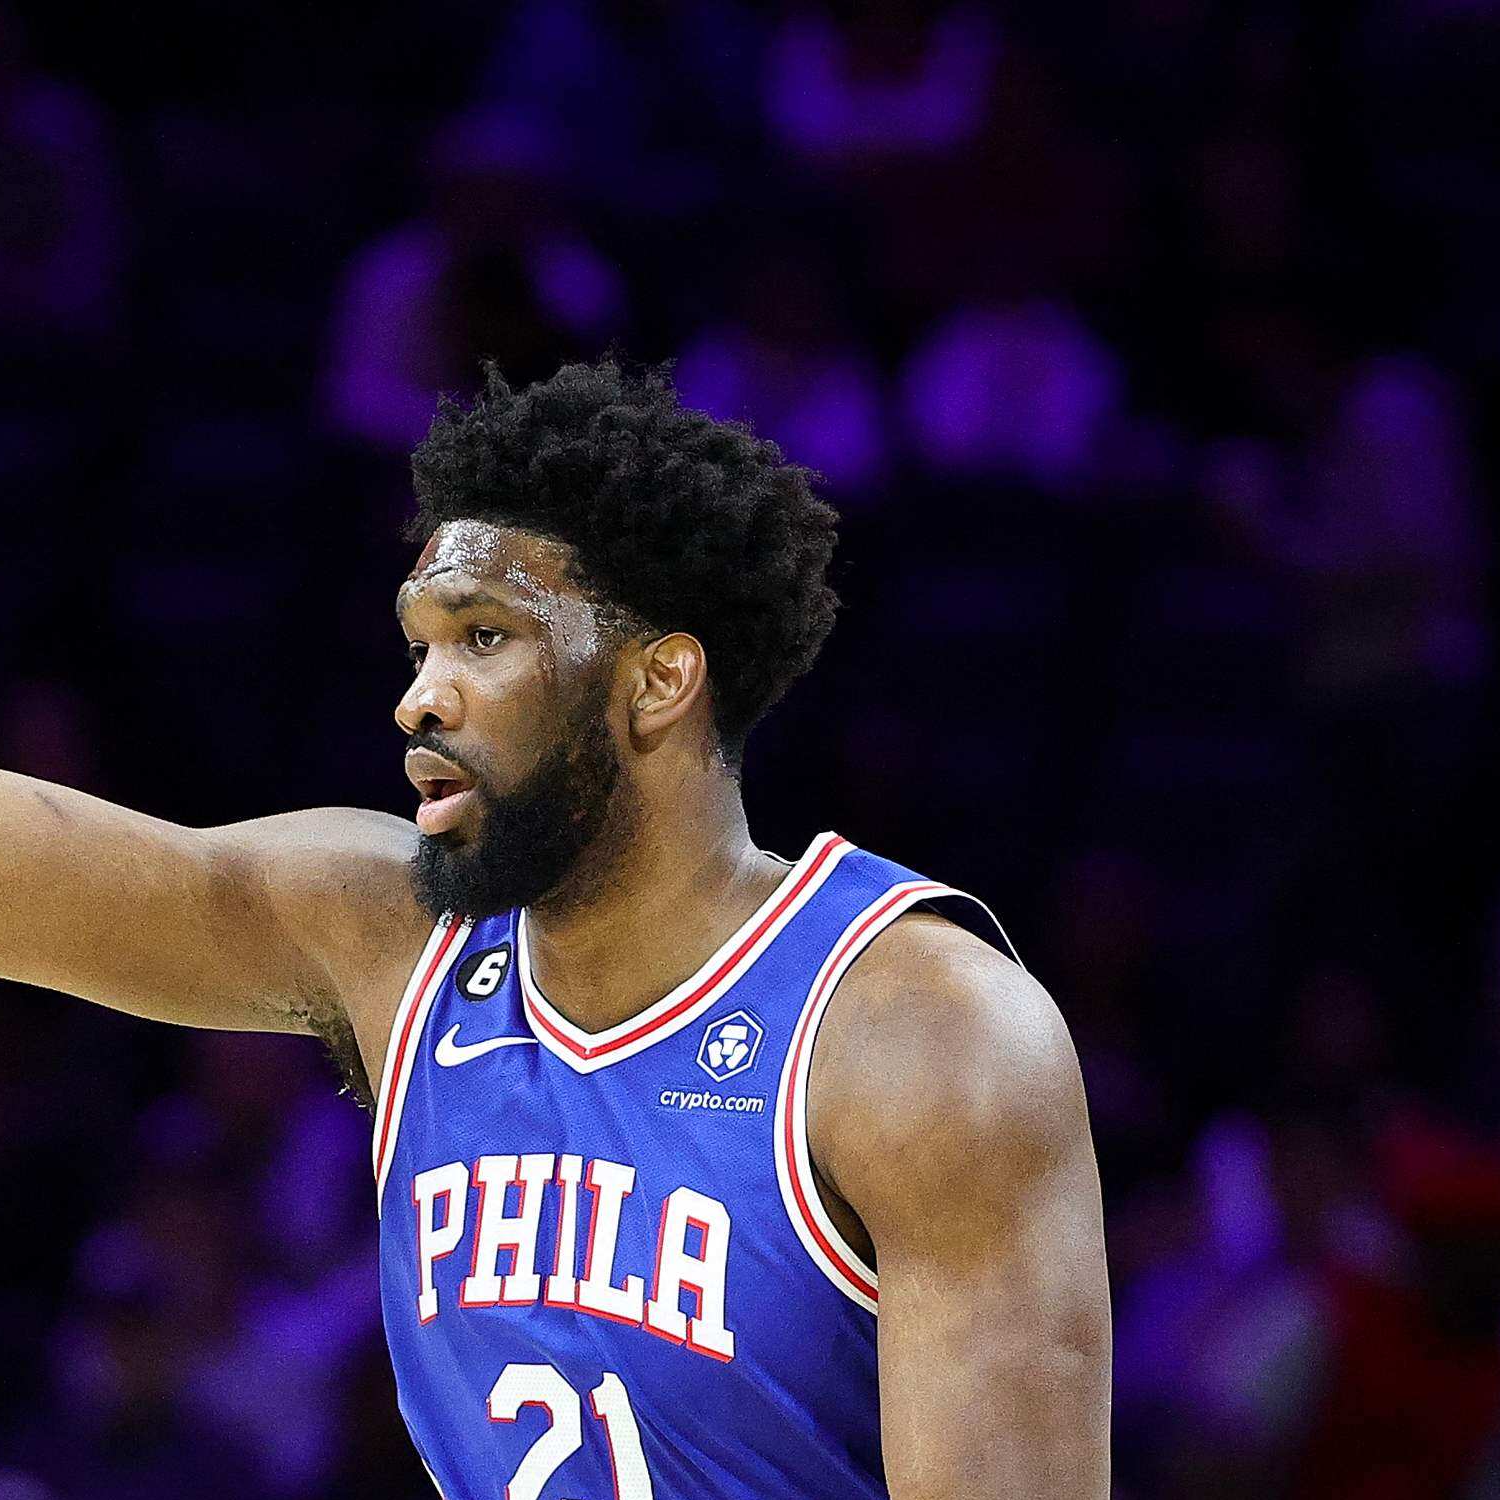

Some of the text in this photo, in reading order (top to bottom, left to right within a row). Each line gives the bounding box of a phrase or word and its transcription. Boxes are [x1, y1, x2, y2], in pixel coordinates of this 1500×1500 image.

[467, 950, 508, 996] 6
[659, 1088, 766, 1115] crypto.com
[412, 1153, 735, 1363] PHILA
